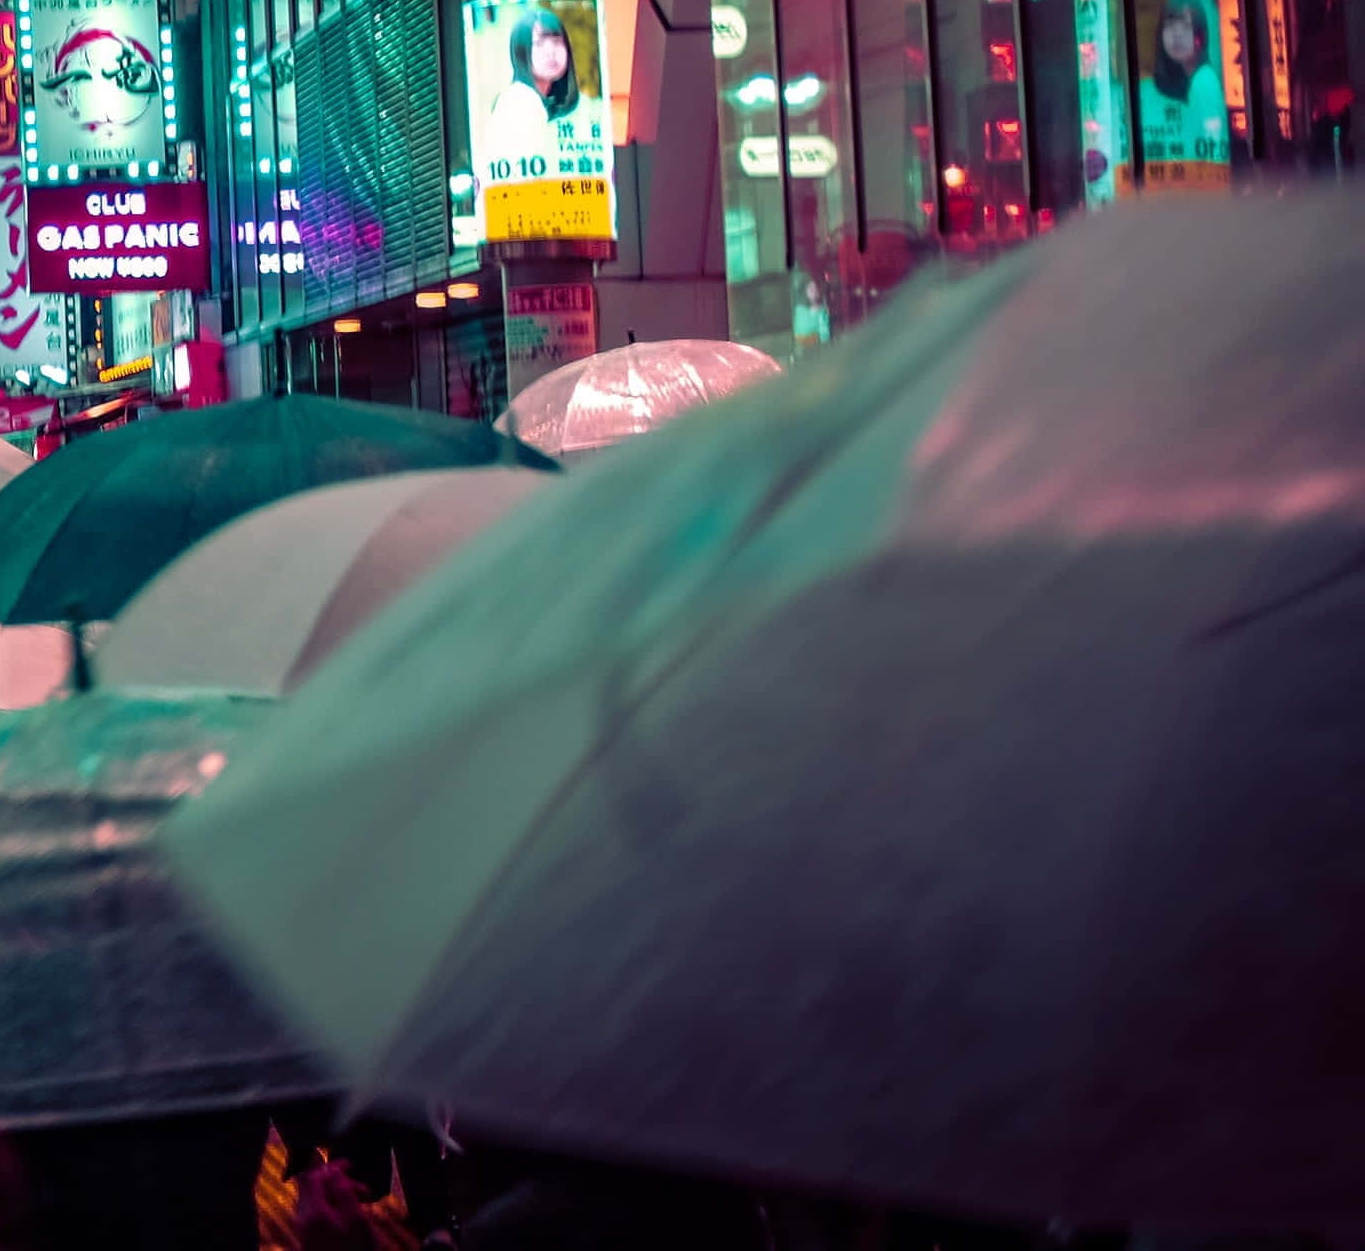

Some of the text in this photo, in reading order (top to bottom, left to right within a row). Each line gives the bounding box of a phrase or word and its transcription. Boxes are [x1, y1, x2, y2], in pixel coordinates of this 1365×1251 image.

[86, 193, 146, 216] CLUB
[36, 222, 199, 252] GAS PANIC
